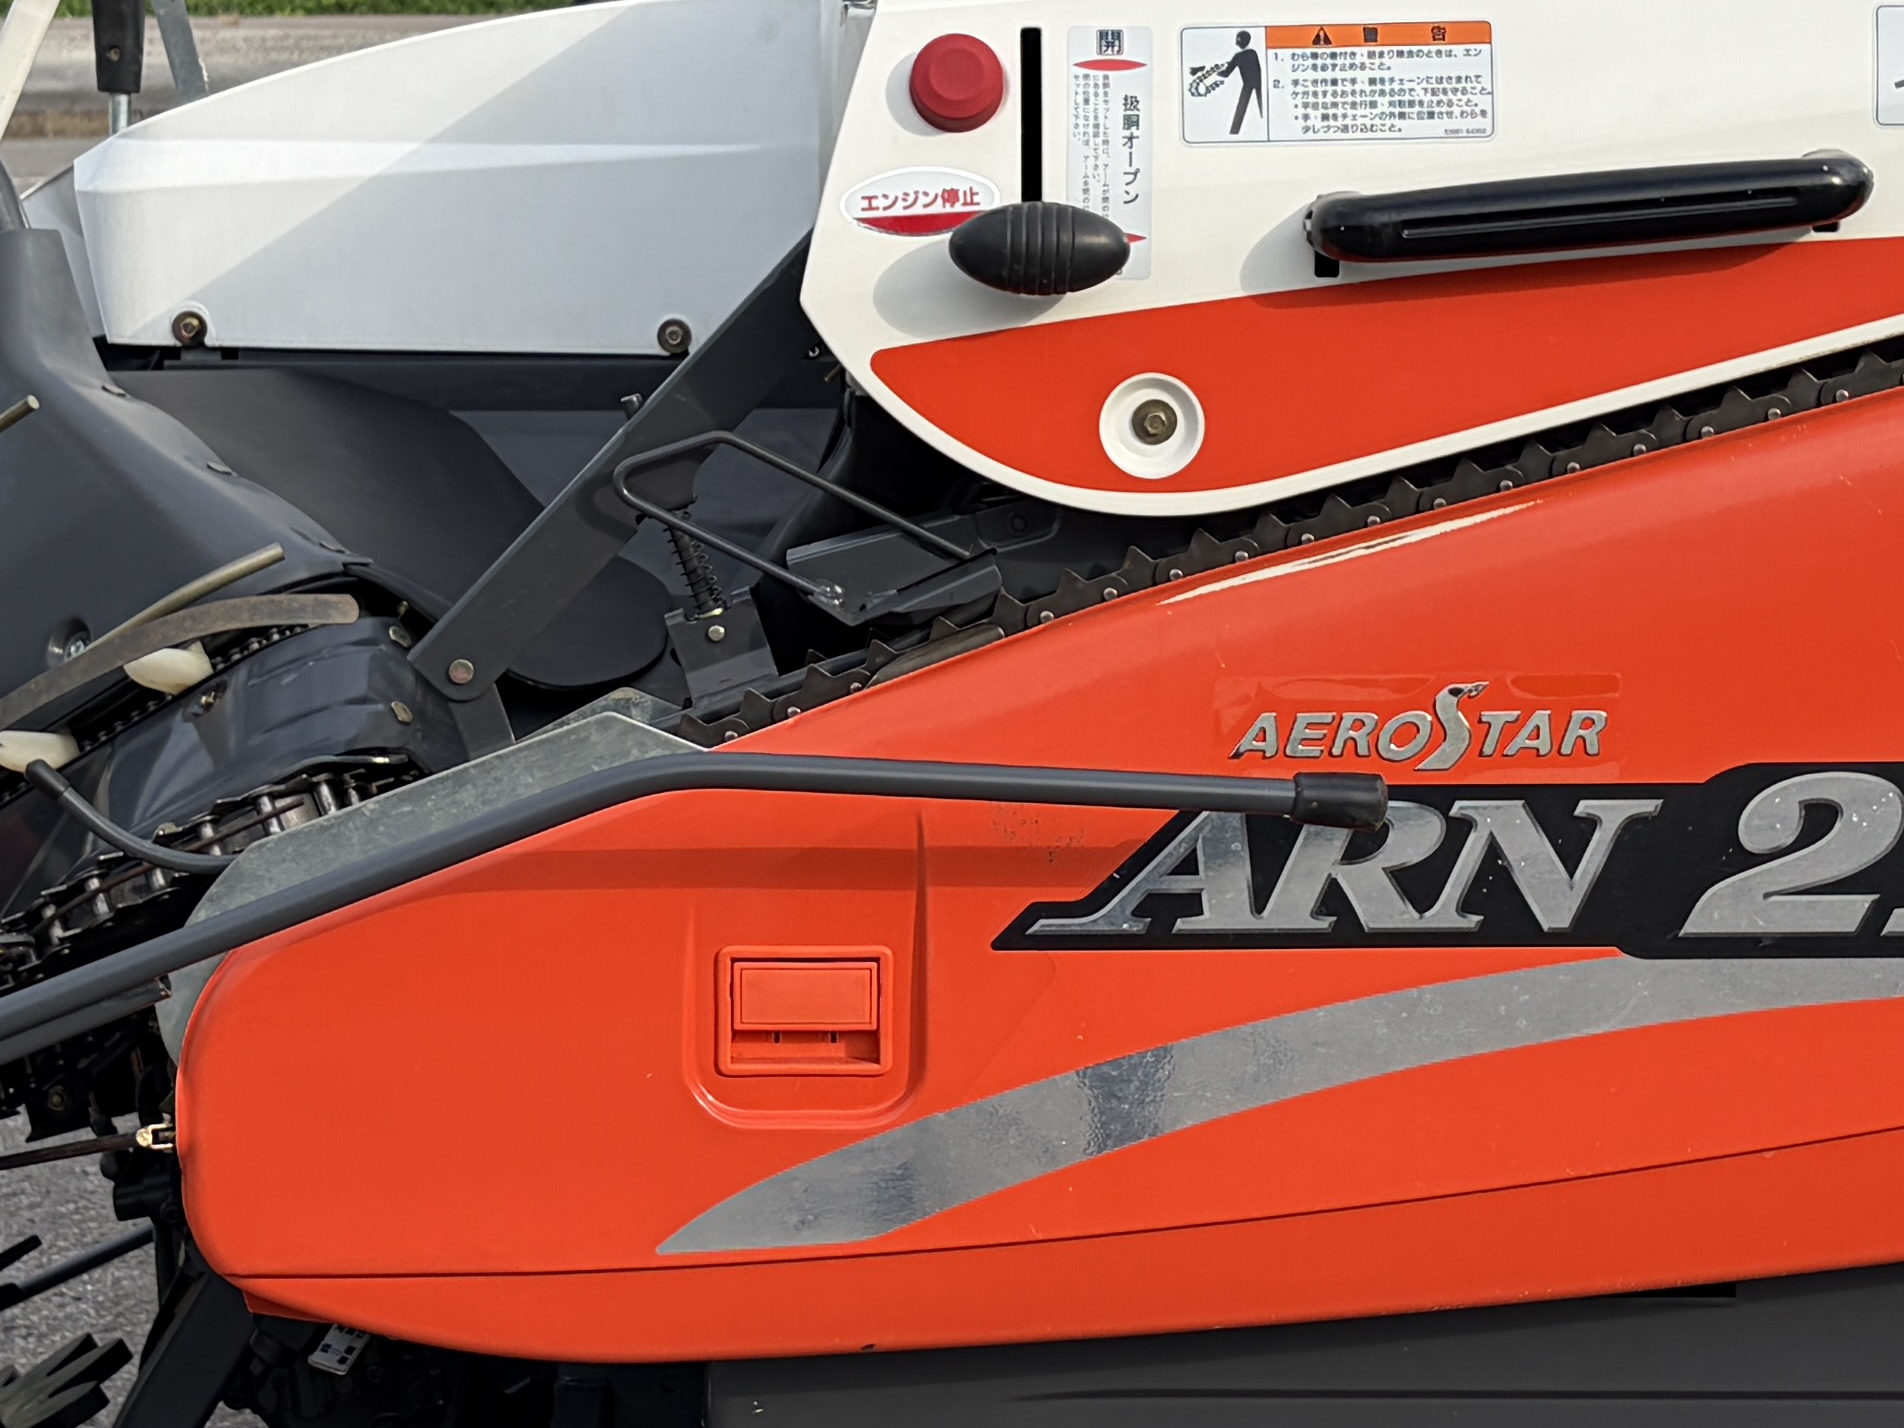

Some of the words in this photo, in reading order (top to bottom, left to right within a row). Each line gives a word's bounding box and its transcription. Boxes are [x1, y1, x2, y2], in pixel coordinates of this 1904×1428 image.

[1099, 30, 1121, 54] 開
[1122, 94, 1140, 205] 扱胴オープン
[861, 186, 980, 211] エンジン停止
[1228, 681, 1608, 771] AEROSTAR
[1026, 798, 1663, 933] ARN
